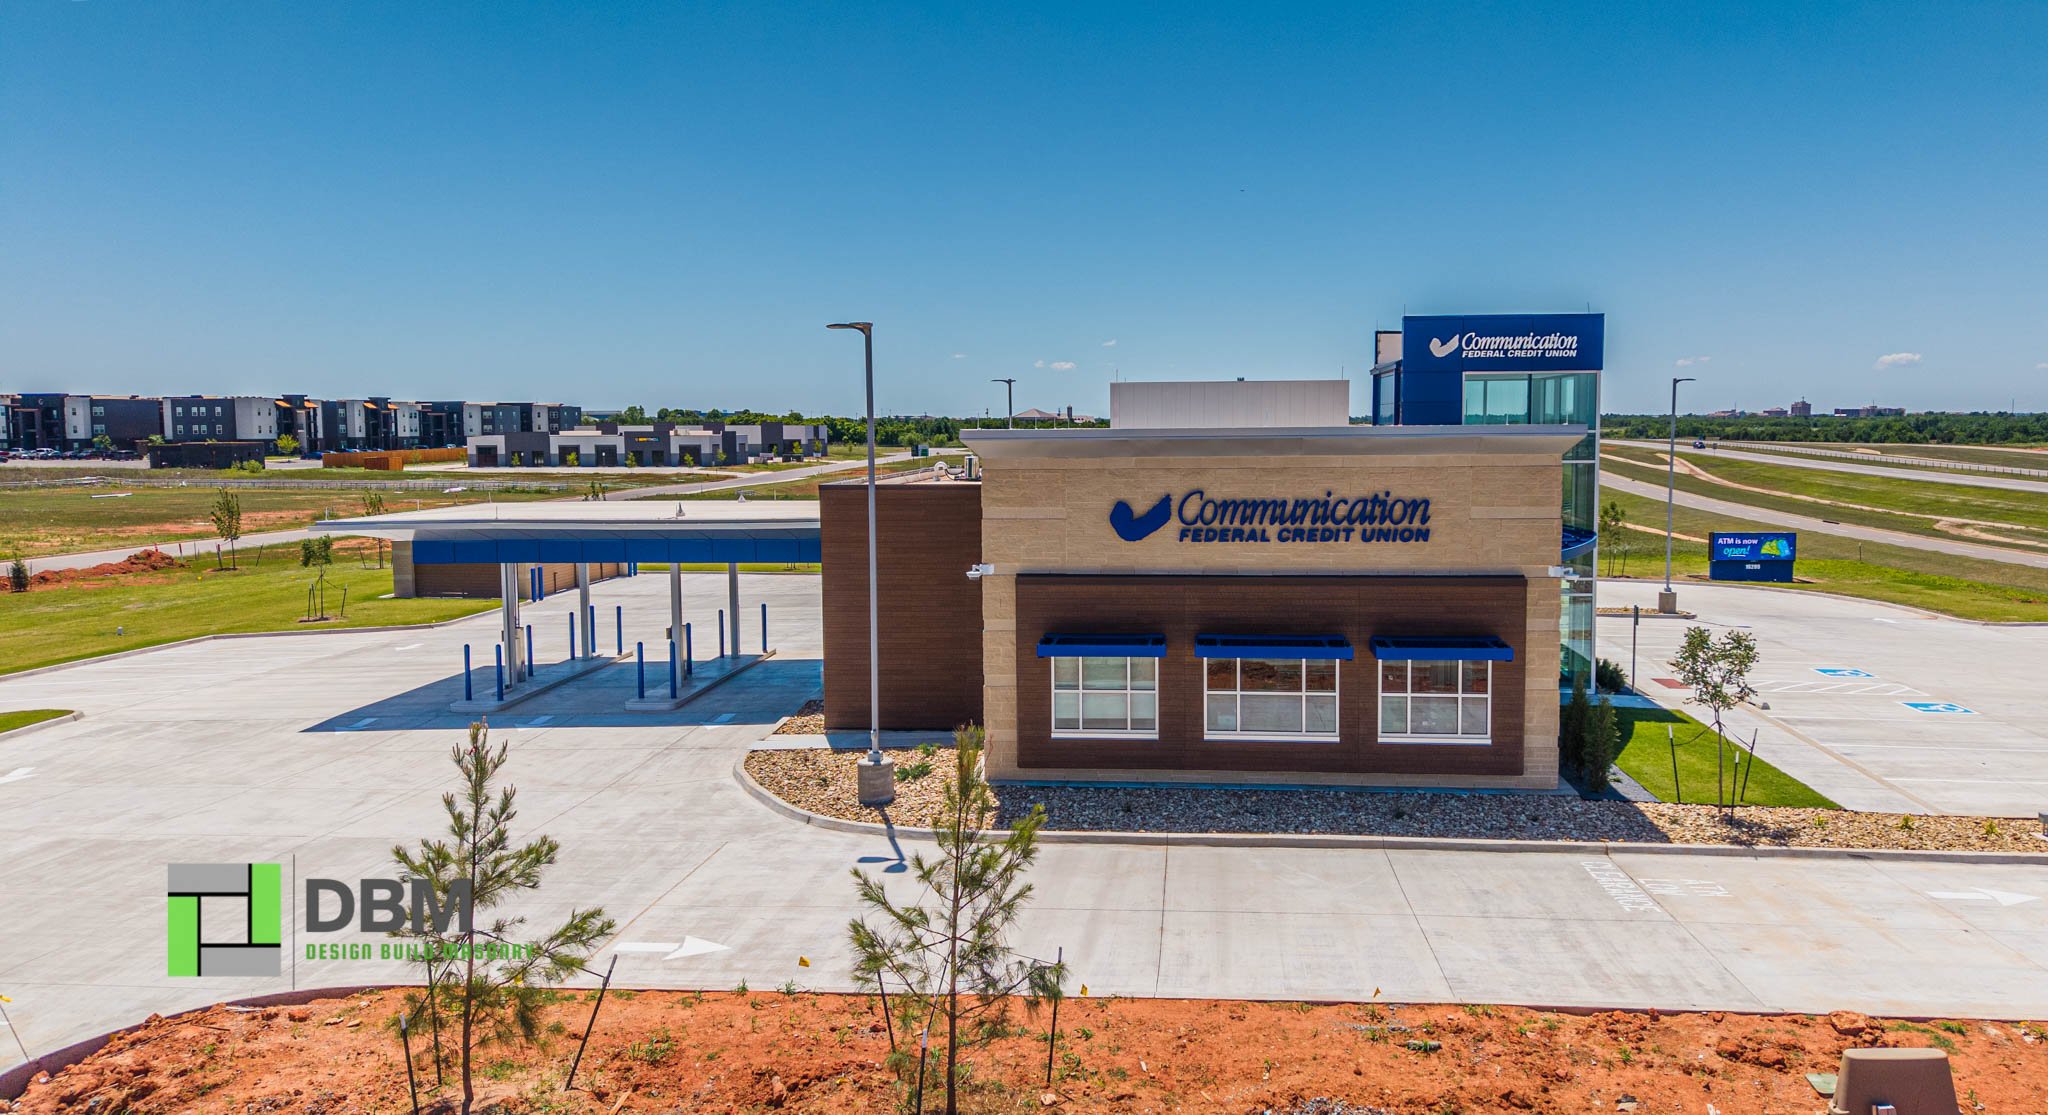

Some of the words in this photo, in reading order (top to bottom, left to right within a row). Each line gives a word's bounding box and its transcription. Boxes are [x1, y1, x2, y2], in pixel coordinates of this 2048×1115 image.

[1462, 332, 1578, 350] Communication
[1462, 350, 1505, 358] FEDERAL
[1507, 350, 1544, 358] CREDIT
[1545, 349, 1577, 358] UNION
[1178, 490, 1431, 526] Communication
[1179, 529, 1271, 542] FEDERAL
[1277, 529, 1354, 542] CREDIT
[1361, 529, 1430, 542] UNION
[1723, 545, 1751, 557] open!
